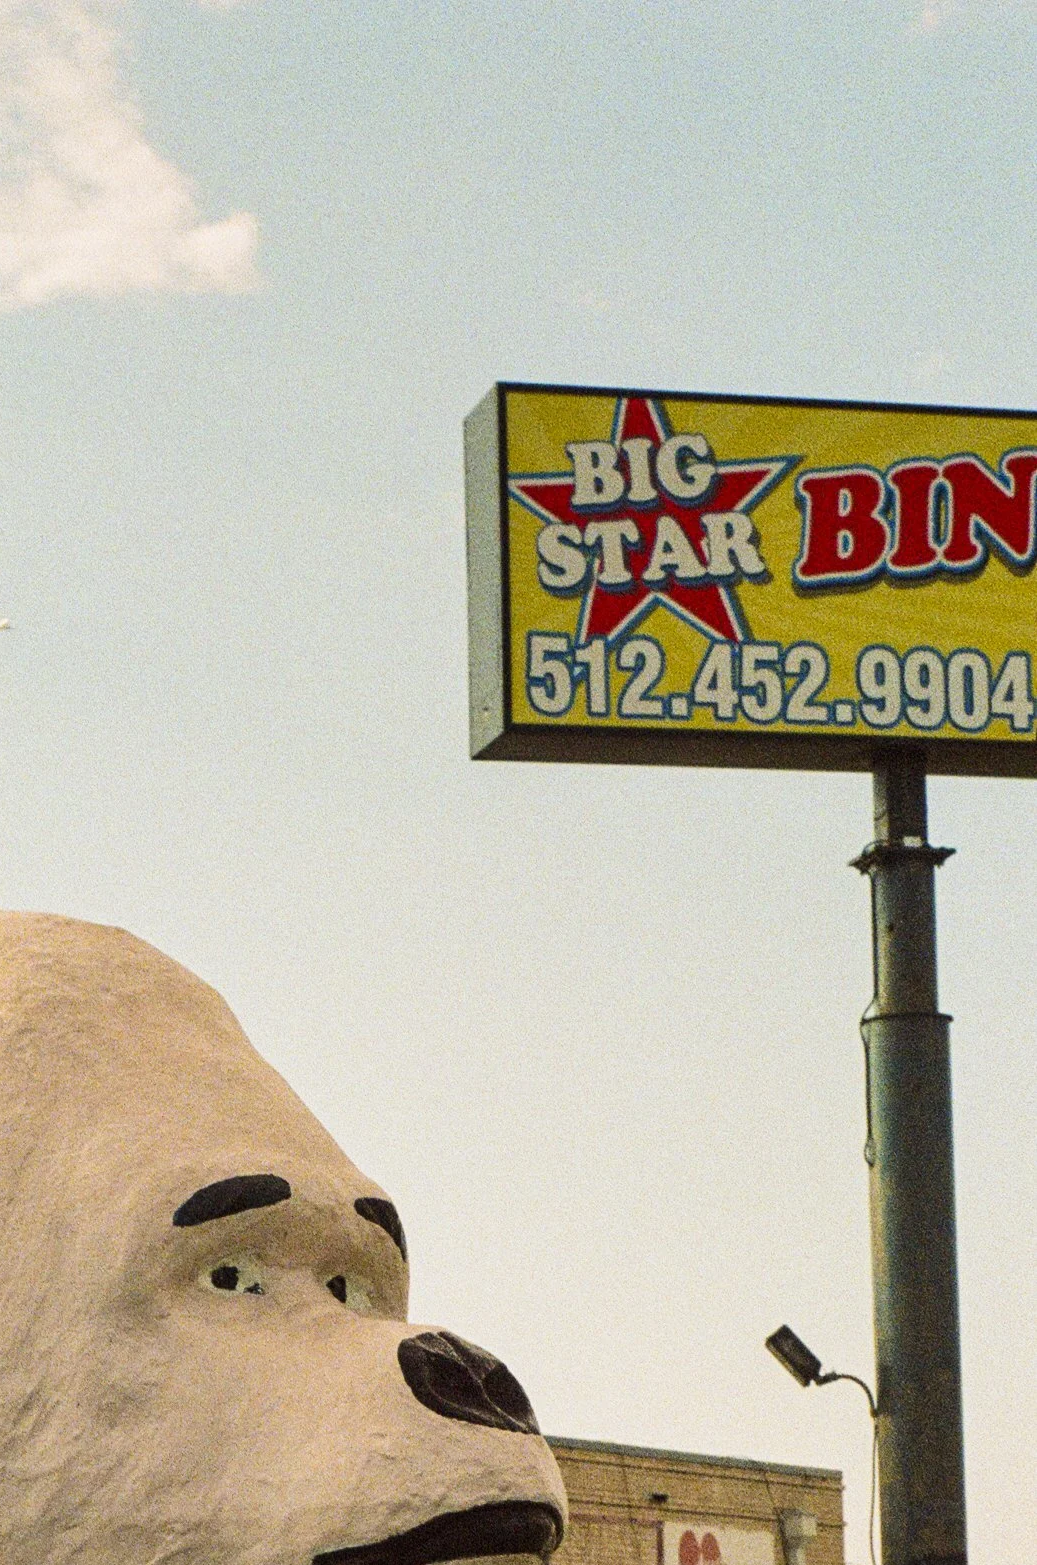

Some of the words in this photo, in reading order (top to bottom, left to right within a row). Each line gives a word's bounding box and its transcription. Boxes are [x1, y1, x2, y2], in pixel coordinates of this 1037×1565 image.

[567, 434, 716, 507] BIG
[535, 511, 766, 590] STAR
[795, 450, 1037, 584] BIN
[527, 632, 1036, 731] 512.452.9904
